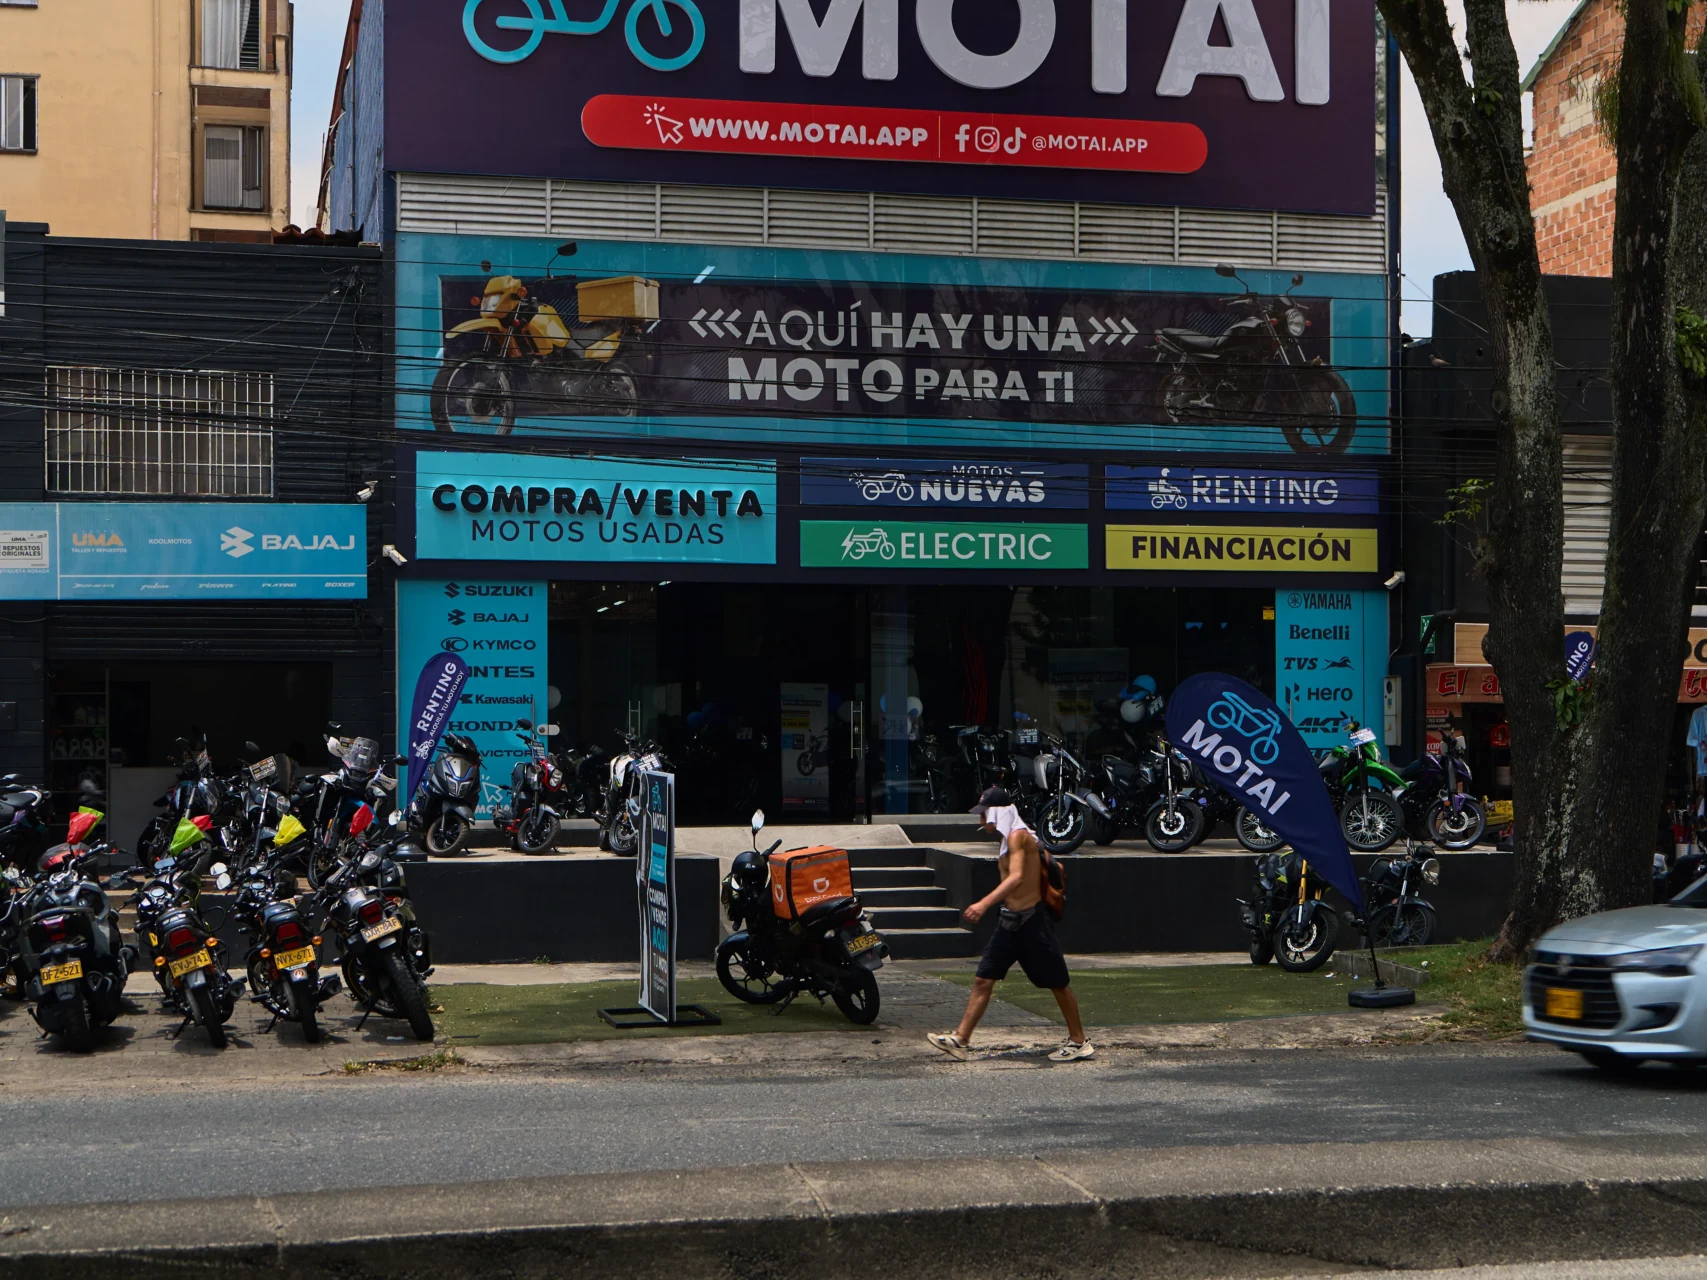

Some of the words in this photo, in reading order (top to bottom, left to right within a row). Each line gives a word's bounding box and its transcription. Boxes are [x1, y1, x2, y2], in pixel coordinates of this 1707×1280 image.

[689, 117, 928, 148] WWW.MOTAI.APP
[1032, 134, 1149, 154] @MOTAI.APP
[746, 300, 862, 351] AQUÍ
[871, 311, 973, 350] HAY
[984, 314, 1086, 353] UNA
[728, 356, 904, 403] MOTO
[915, 368, 1030, 403] PARA
[1038, 371, 1075, 403] TI
[432, 482, 763, 521] COMPRA/VENTA
[920, 479, 1046, 503] NUEVAS
[1192, 475, 1339, 506] RENTING
[72, 533, 124, 547] UMA
[262, 534, 355, 550] BAJAJ
[471, 519, 584, 543] MOTOS
[599, 522, 724, 545] USADAS
[901, 532, 1052, 561] ELECTRIC
[1132, 532, 1351, 562] FINANCIACIÓN
[464, 585, 533, 597] SUZUKI
[1303, 592, 1352, 610] YAMAHA
[473, 612, 529, 623] BAJAJ
[1289, 624, 1351, 641] Benelli
[472, 639, 536, 651] KYMCO
[468, 665, 535, 678] NTES
[1284, 657, 1318, 671] TVS
[1437, 667, 1467, 696] El
[1481, 673, 1502, 696] a
[416, 661, 457, 733] RENTING
[429, 712, 445, 737] ALQUILA
[445, 684, 458, 704] MOTO
[454, 670, 465, 687] HOY
[475, 694, 534, 705] Kawasaki
[447, 721, 529, 732] HONDA
[480, 749, 533, 758] VICTOR
[1181, 719, 1291, 815] MOTAI
[652, 811, 667, 833] MOTAI
